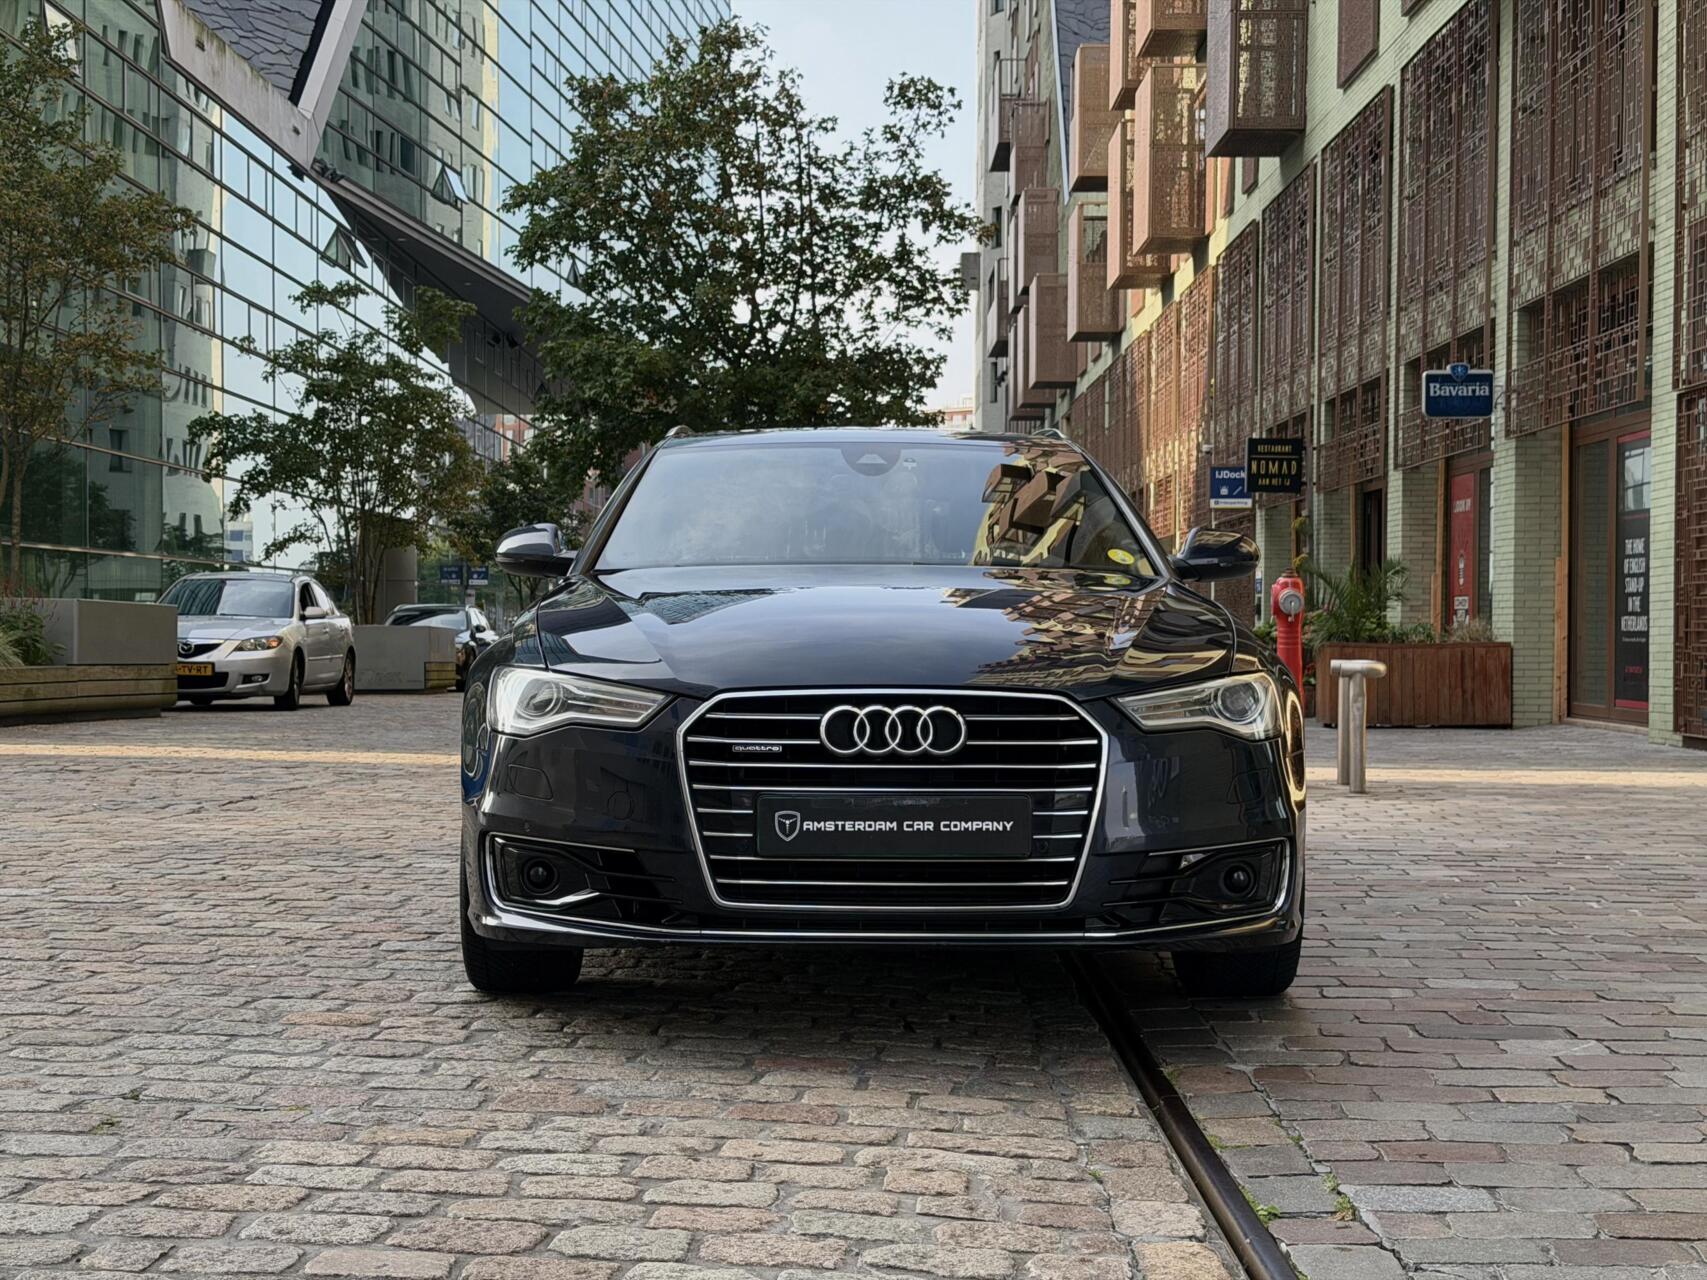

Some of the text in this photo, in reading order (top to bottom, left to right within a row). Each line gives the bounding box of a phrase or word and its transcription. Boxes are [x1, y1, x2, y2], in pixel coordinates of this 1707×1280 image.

[1429, 382, 1489, 397] Bavaria
[1257, 445, 1292, 453] RESTAURANT
[1251, 460, 1297, 475] NOMAD
[1633, 537, 1645, 554] HOME
[1624, 558, 1629, 574] OF
[1625, 577, 1644, 593] STAND-UP
[1621, 615, 1648, 631] NETHERLANDS
[803, 821, 1013, 832] AMSTERDAM CAR COMPANY
